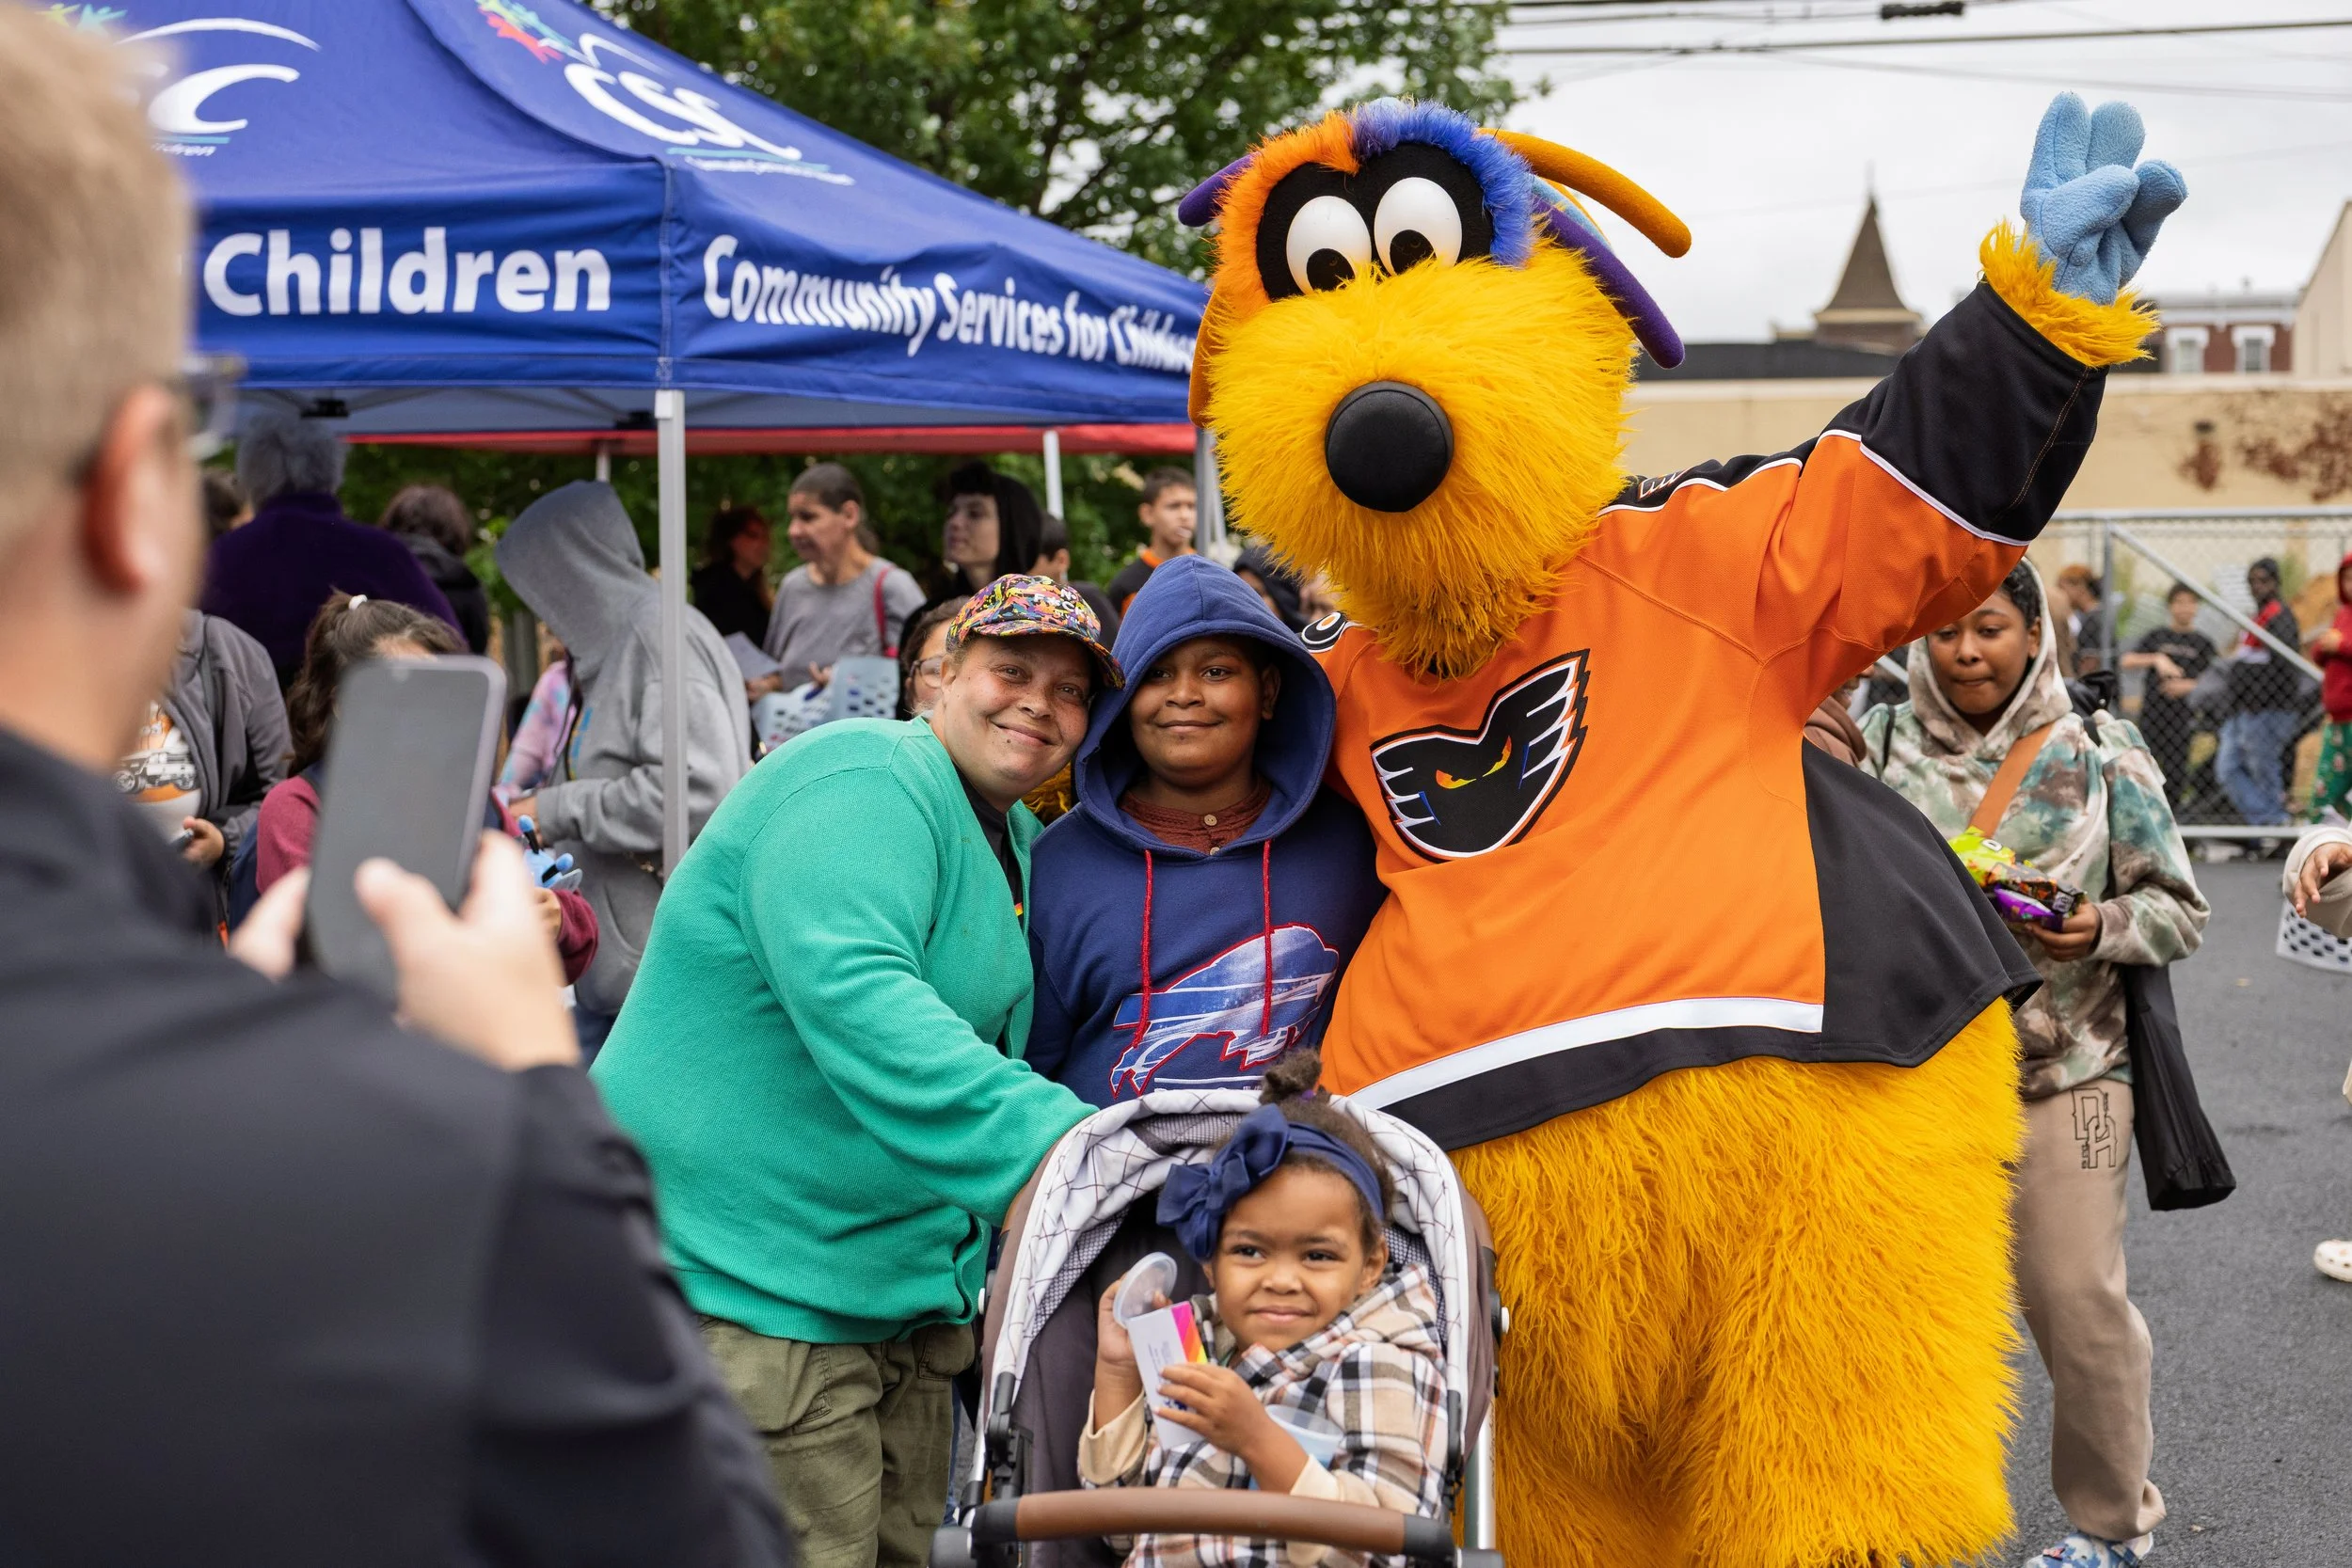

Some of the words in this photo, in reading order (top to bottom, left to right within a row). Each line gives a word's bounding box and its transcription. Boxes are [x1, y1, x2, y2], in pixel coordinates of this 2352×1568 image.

[203, 227, 612, 317] Children
[703, 233, 938, 358] Community
[933, 272, 1066, 356] Services
[1063, 291, 1109, 362] for
